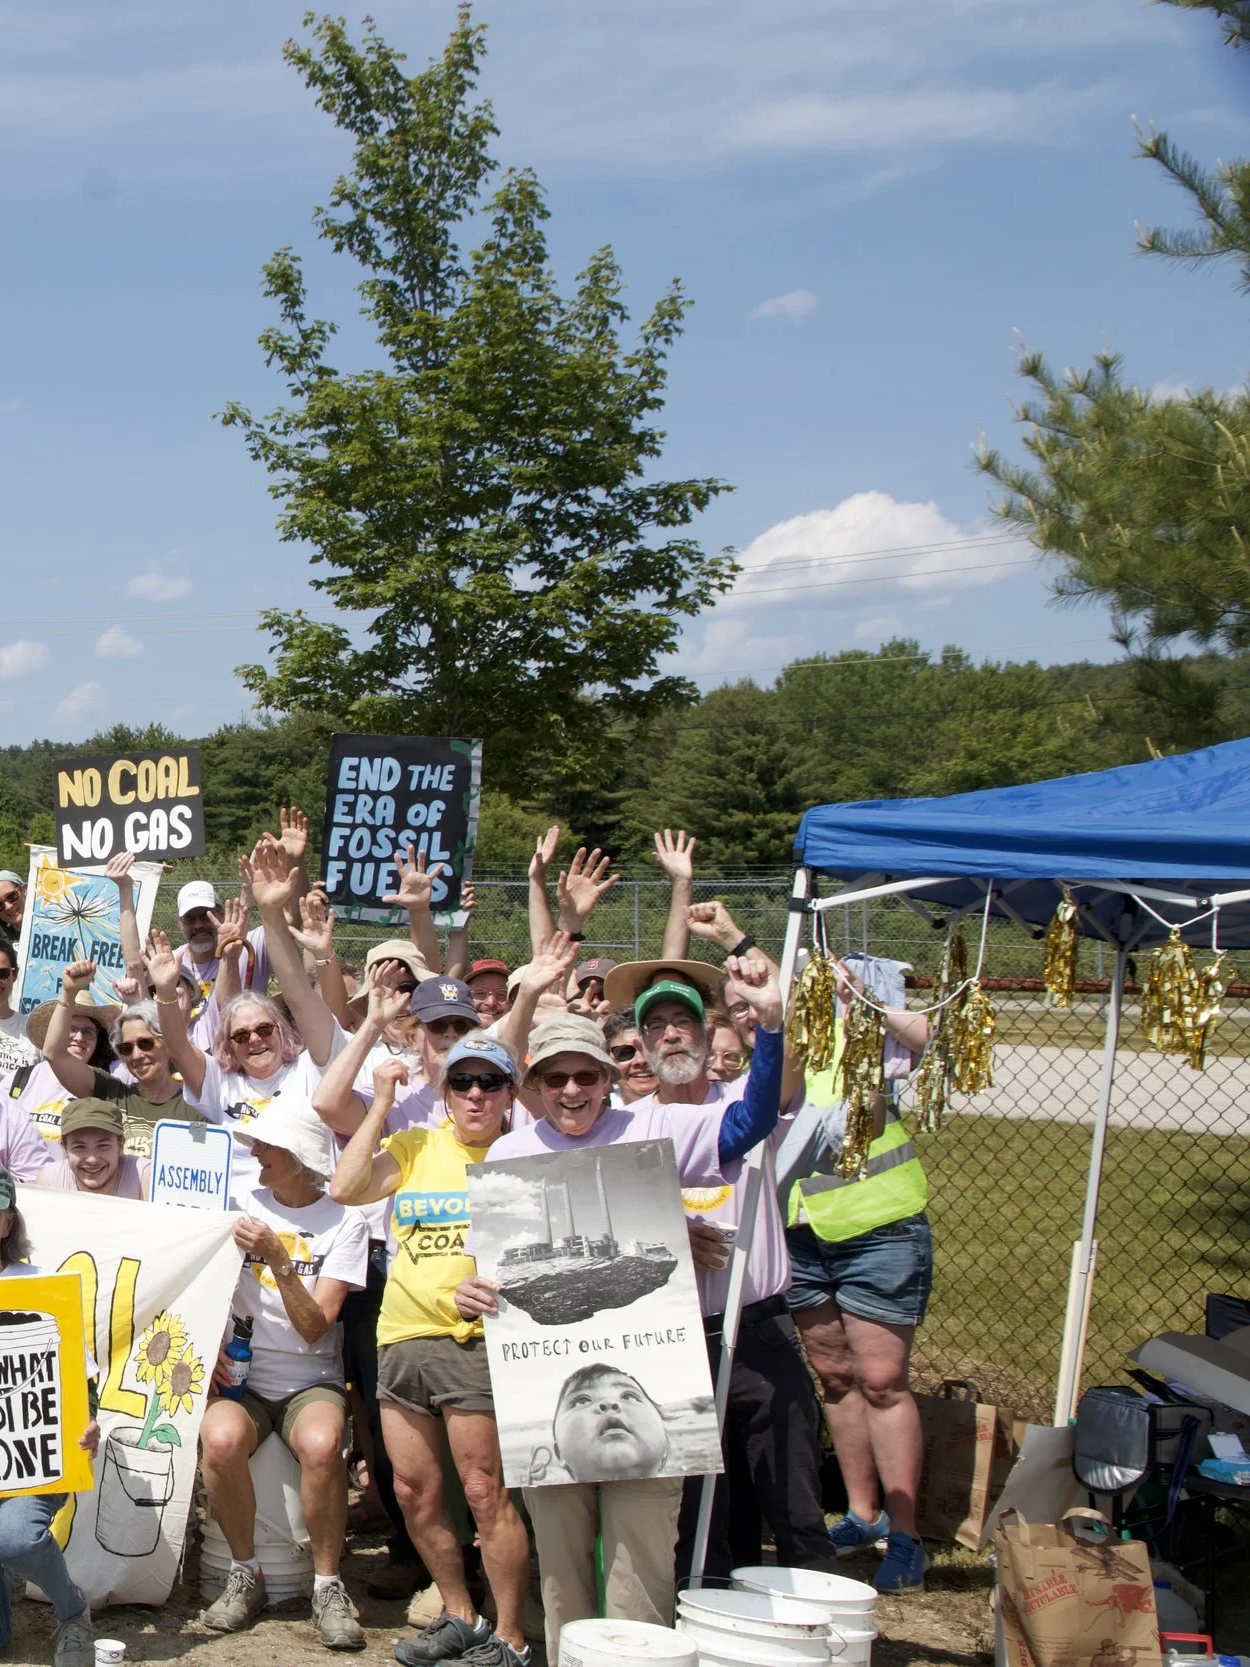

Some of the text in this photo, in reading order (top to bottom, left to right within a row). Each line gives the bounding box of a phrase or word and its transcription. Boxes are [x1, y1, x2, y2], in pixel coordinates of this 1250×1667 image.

[58, 755, 200, 808] NO COAL
[337, 757, 456, 792] END THE
[332, 794, 396, 826] ERA
[62, 804, 192, 861] NO GAS
[328, 827, 450, 861] FOSSIL
[326, 861, 454, 903] FUES
[31, 933, 78, 962] BREAK
[38, 1114, 56, 1125] COAL
[157, 1164, 223, 1195] ASSEMBLY
[399, 1197, 470, 1218] BEYO
[417, 1231, 465, 1250] COA
[297, 1263, 314, 1275] GAS
[502, 1327, 686, 1361] PROTECT OUR FUTURE
[21, 1387, 58, 1430] BE
